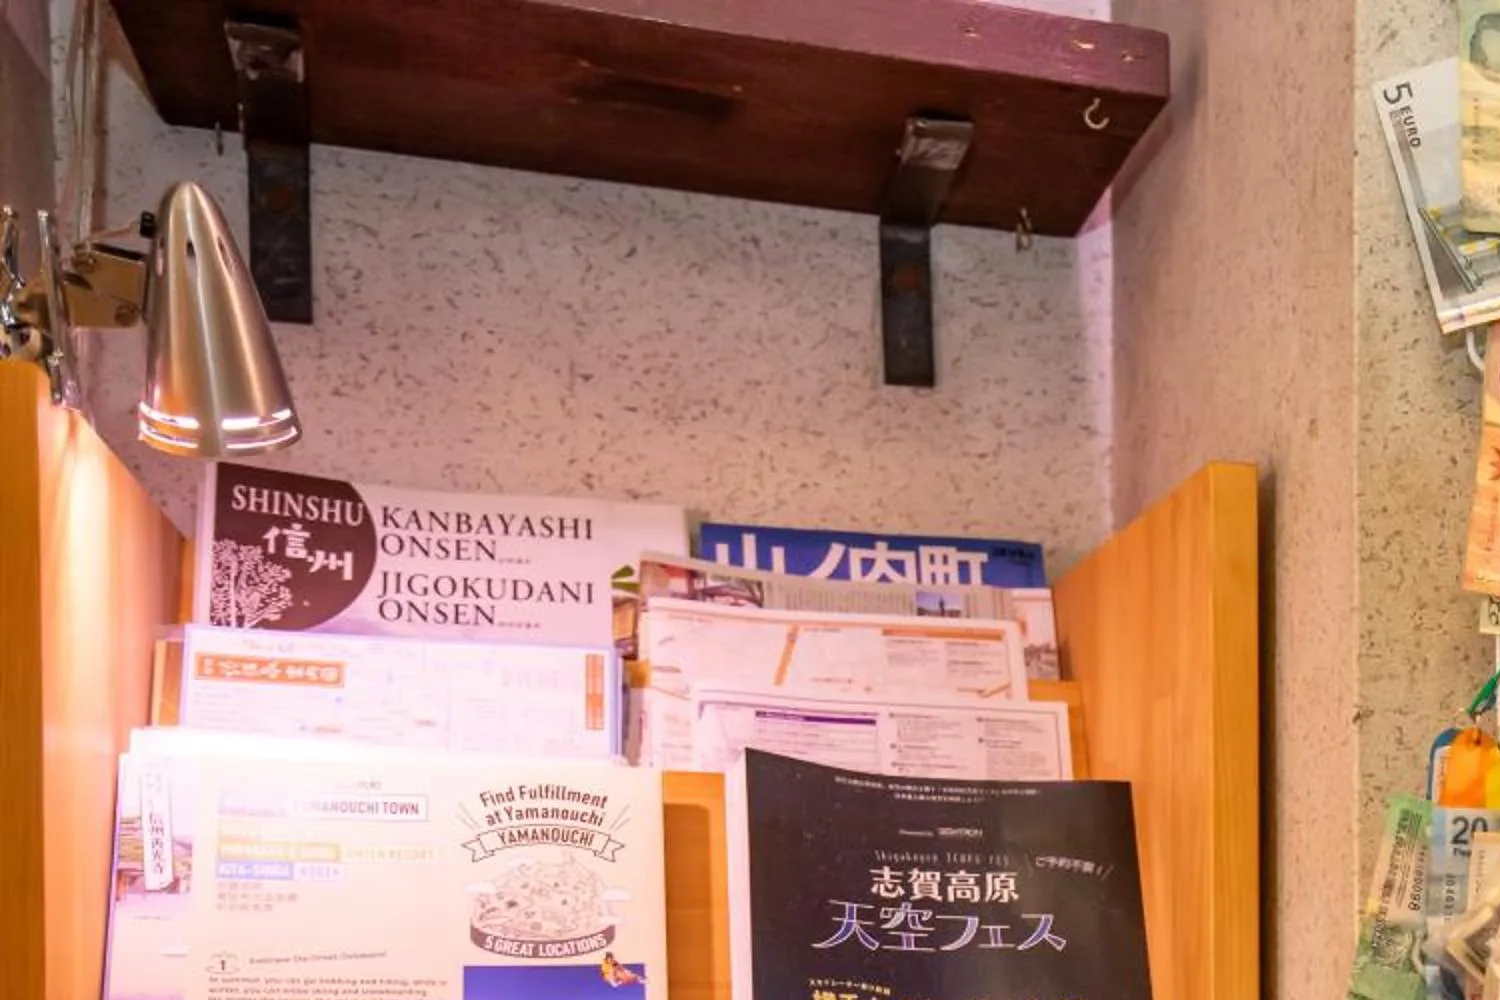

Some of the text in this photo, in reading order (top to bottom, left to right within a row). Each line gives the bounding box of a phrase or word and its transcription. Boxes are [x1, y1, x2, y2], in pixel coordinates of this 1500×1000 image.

[1383, 81, 1423, 149] 5 EURO
[231, 483, 365, 527] SHINSHU
[380, 505, 595, 541] KANBAYASHI
[262, 521, 355, 582] 信州
[380, 533, 499, 563] ONSEN
[714, 533, 992, 588] 山ノ内町
[378, 570, 595, 605] JIGOKUDANI
[378, 599, 497, 629] ONSEN
[383, 801, 420, 816] TOWN
[479, 784, 608, 809] Find Fulfillment
[486, 806, 605, 827] at Yamanouchi
[499, 828, 595, 846] YAMANOUCHI
[869, 867, 1021, 904] 志賀高原
[810, 897, 1069, 954] 天空フェス
[485, 935, 606, 956] 5 GREAT LOCATIONS
